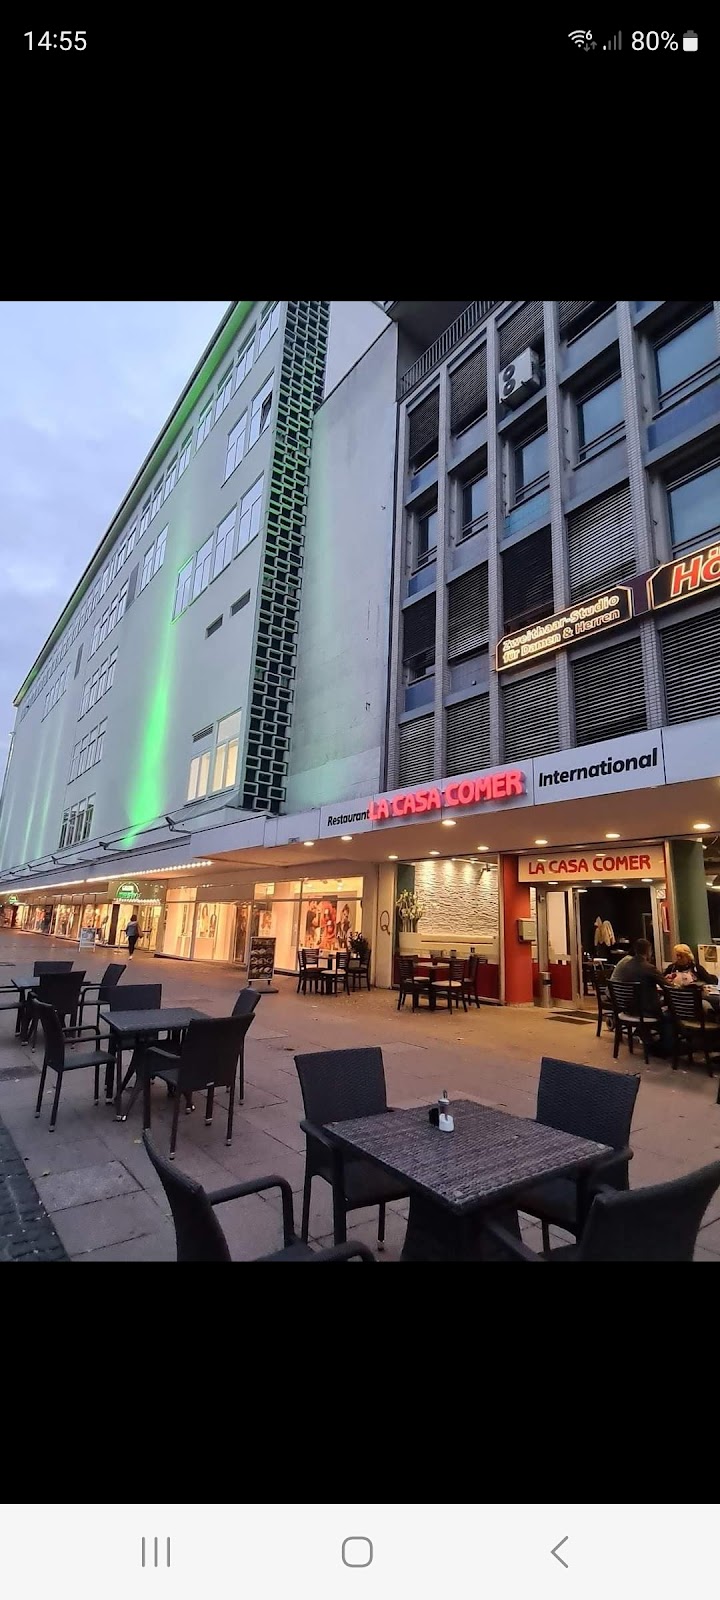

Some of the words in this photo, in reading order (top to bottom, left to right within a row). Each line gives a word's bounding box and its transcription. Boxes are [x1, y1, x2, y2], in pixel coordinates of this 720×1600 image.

[503, 595, 620, 651] Zweithaar-Studio
[503, 648, 520, 664] für
[521, 633, 561, 656] Damen
[562, 627, 574, 639] &
[575, 609, 620, 635] Herren
[327, 810, 369, 827] Restaurant
[368, 798, 390, 821] LA
[391, 786, 442, 816] CASA
[444, 769, 525, 808] COMER
[539, 747, 658, 787] International
[528, 861, 545, 875] LA
[548, 858, 589, 874] CASA
[592, 854, 652, 872] COMER
